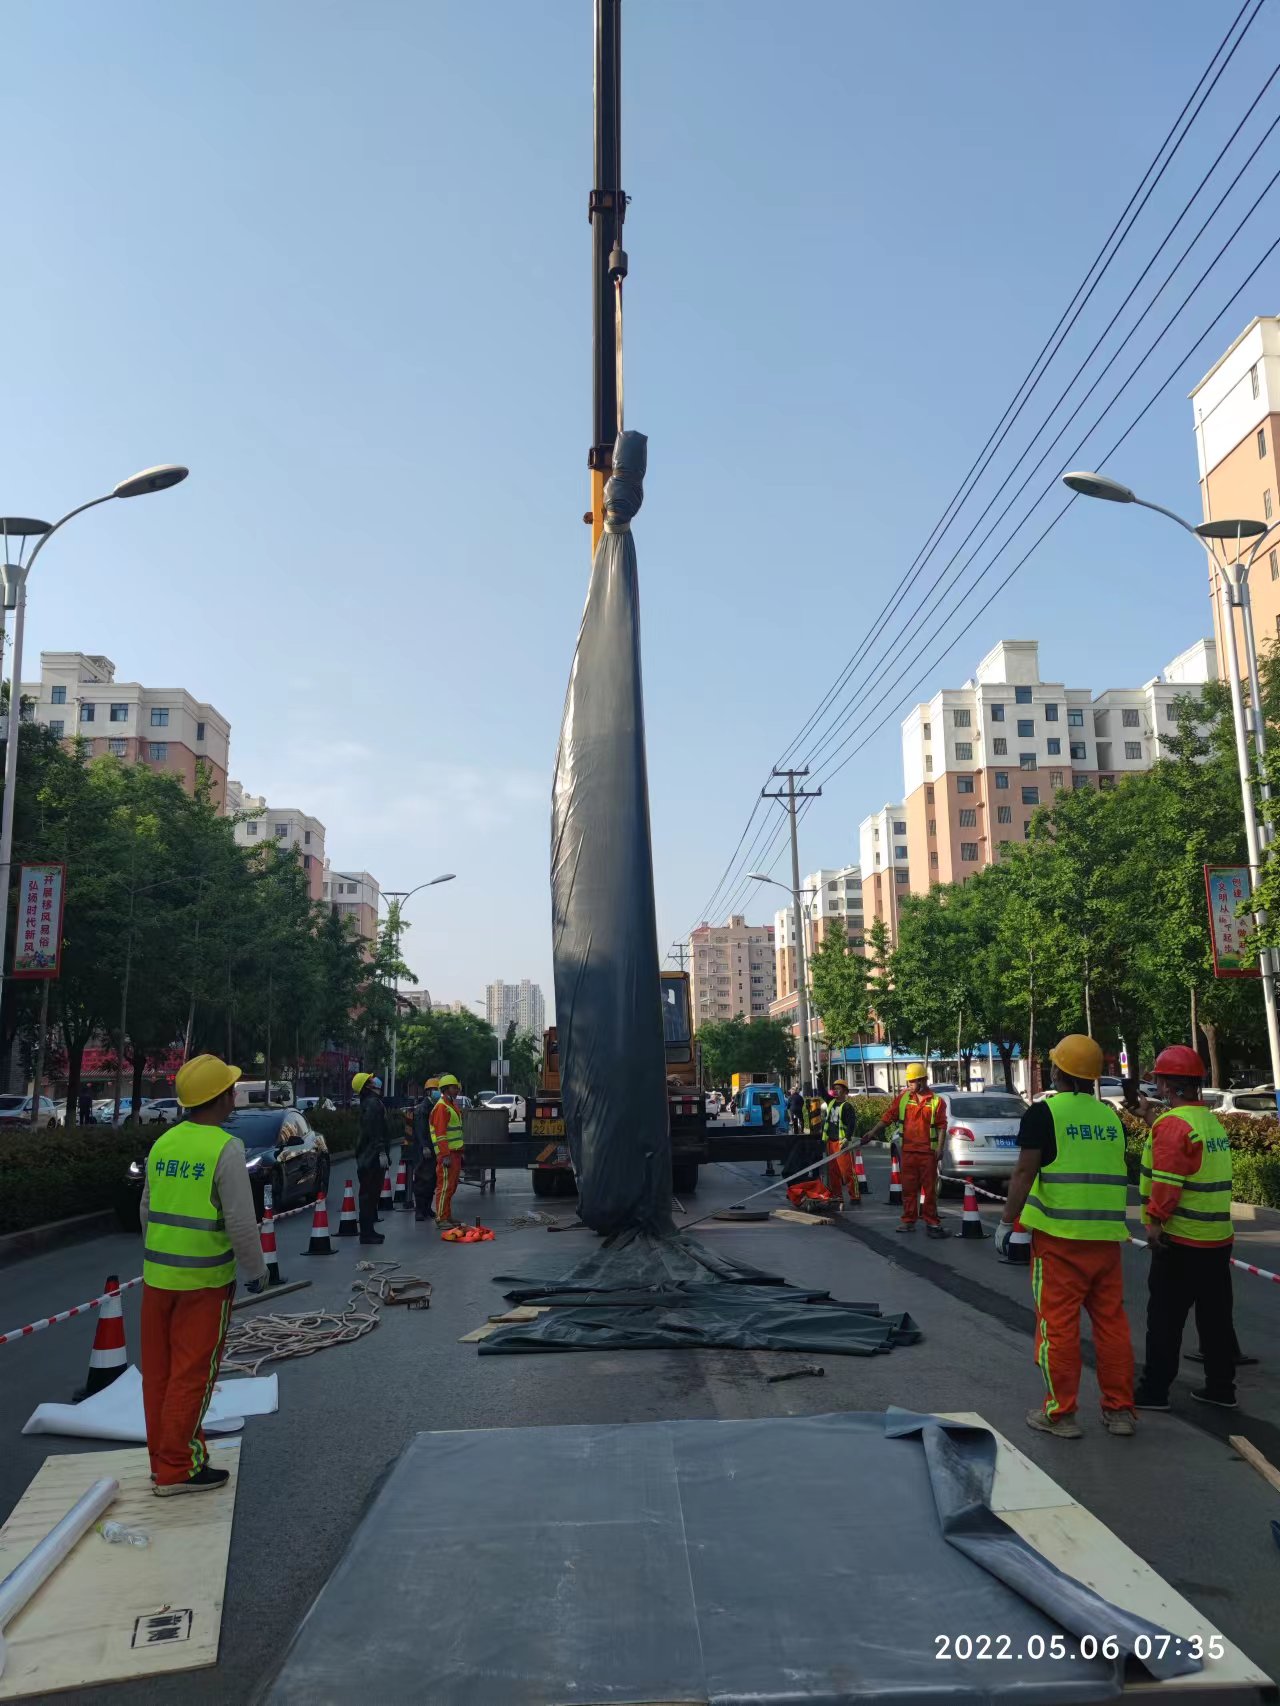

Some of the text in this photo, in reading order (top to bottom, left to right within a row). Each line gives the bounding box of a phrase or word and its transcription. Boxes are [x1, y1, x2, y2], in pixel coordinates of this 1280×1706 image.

[24, 881, 38, 952] 弘扬时代新风
[40, 875, 54, 947] 开展移风易俗
[1066, 1124, 1118, 1141] 中国化学
[156, 1158, 205, 1180] 中国化学
